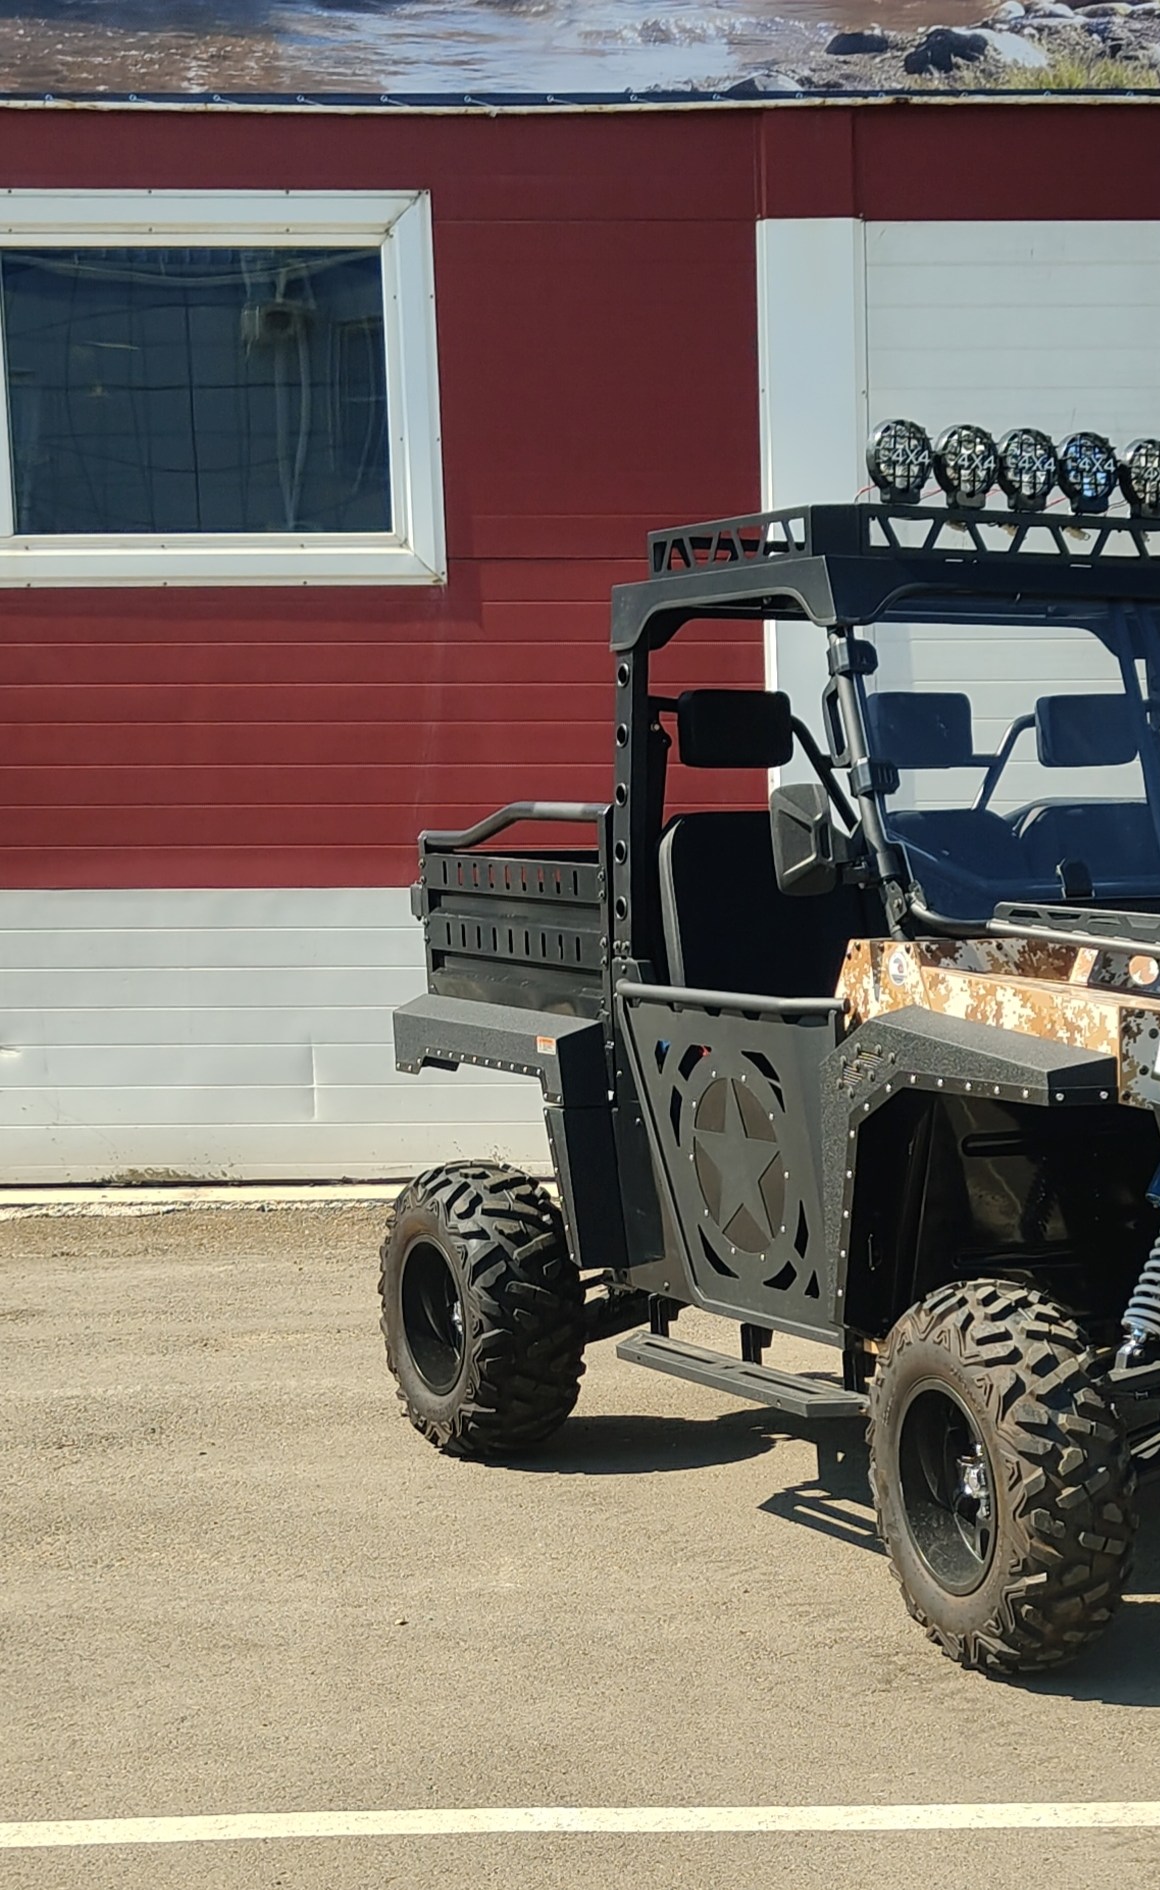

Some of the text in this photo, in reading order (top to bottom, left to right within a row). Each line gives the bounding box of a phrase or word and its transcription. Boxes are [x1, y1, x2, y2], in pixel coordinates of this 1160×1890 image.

[891, 447, 931, 465] 4X4
[957, 452, 996, 471] 4X4
[1018, 454, 1056, 473] 4X4
[1078, 454, 1116, 473] 4X4
